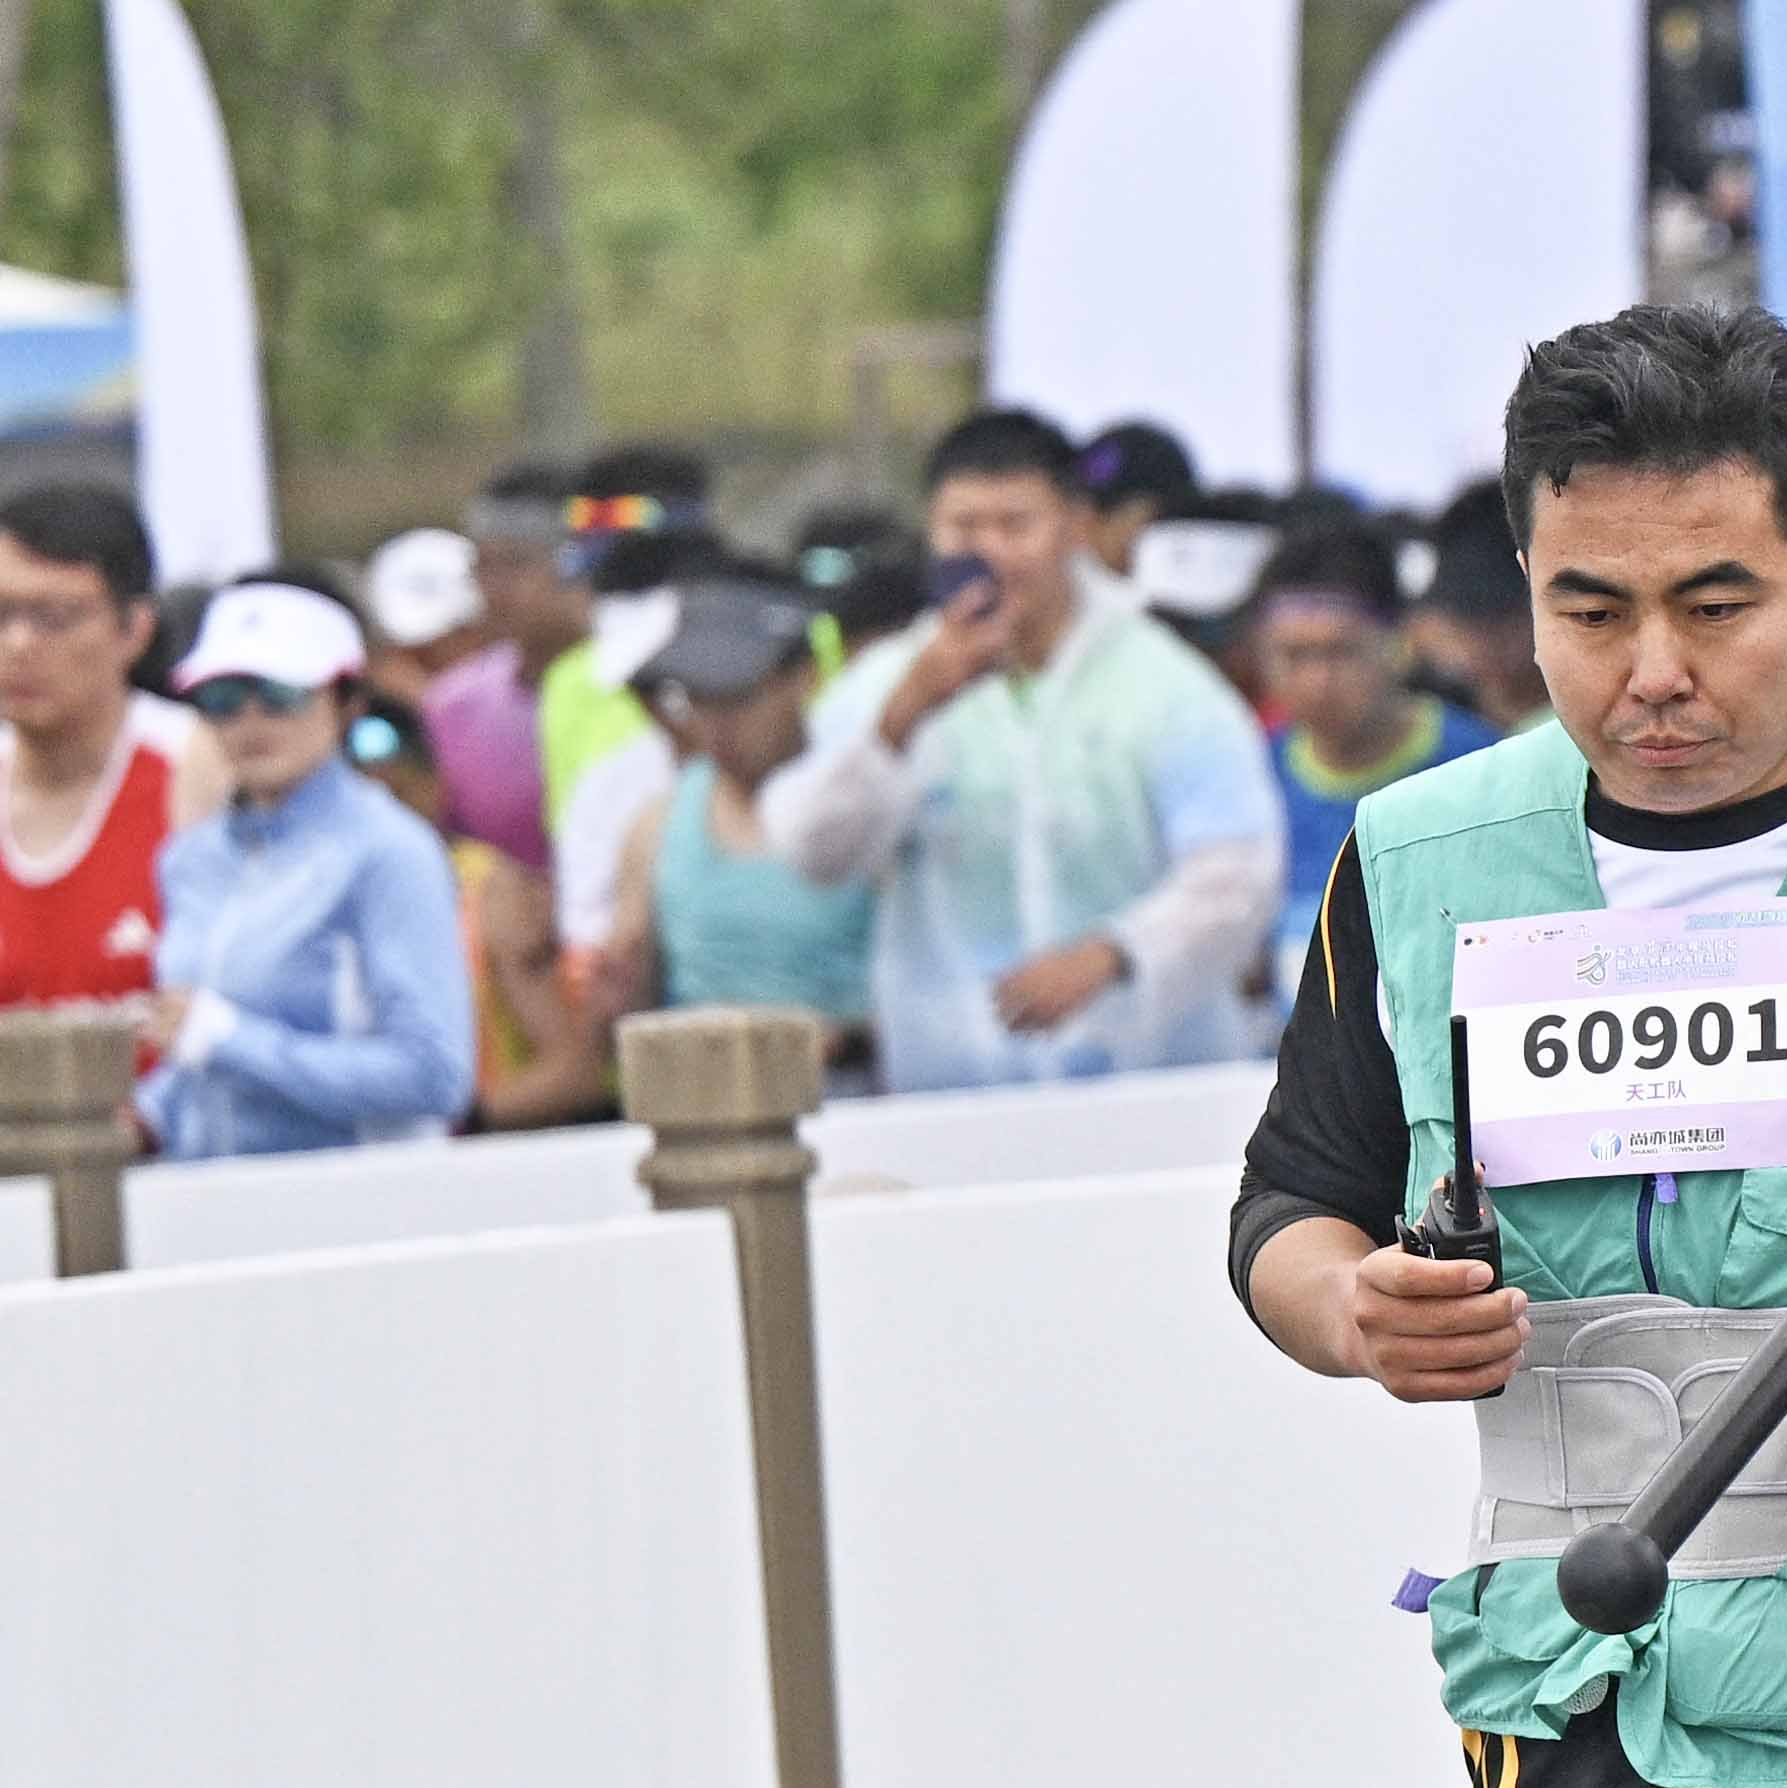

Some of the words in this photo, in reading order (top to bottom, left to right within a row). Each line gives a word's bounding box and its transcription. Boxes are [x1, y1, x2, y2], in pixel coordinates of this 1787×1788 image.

[1626, 1080, 1687, 1101] 天工队
[1630, 1127, 1725, 1146] 尚亦城集团
